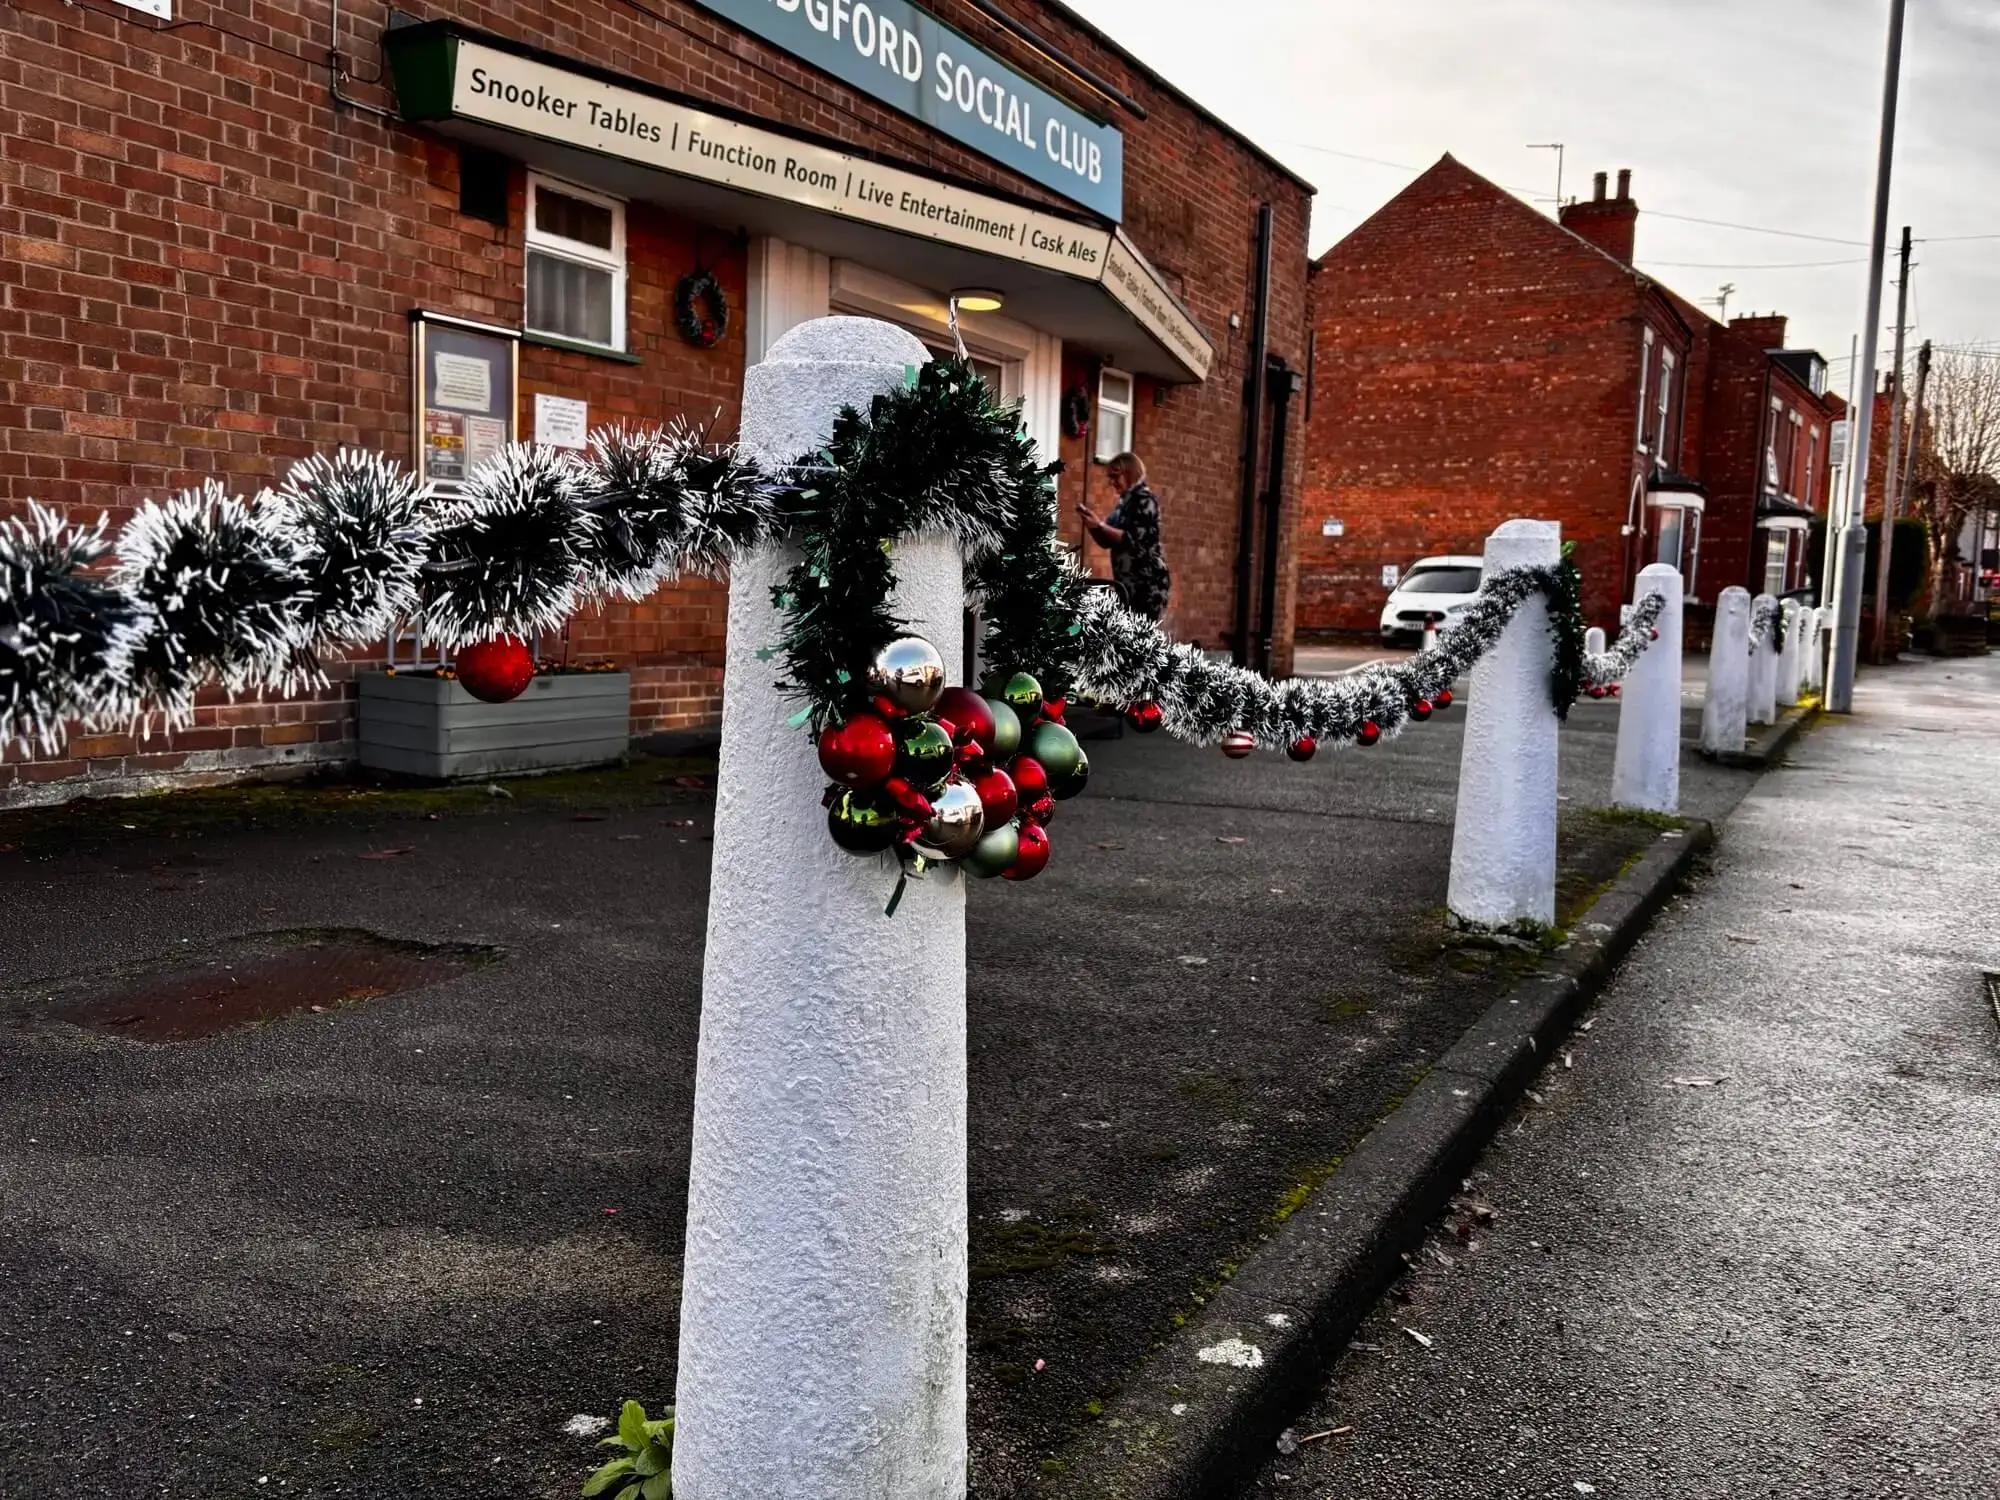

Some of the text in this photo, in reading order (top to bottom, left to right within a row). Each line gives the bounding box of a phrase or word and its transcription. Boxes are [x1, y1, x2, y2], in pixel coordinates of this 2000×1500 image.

[470, 68, 1097, 263] Snooker Tables Function Room Live Entertainment Cask Ales
[776, 0, 1102, 184] GFORD SOCIAL CLUB
